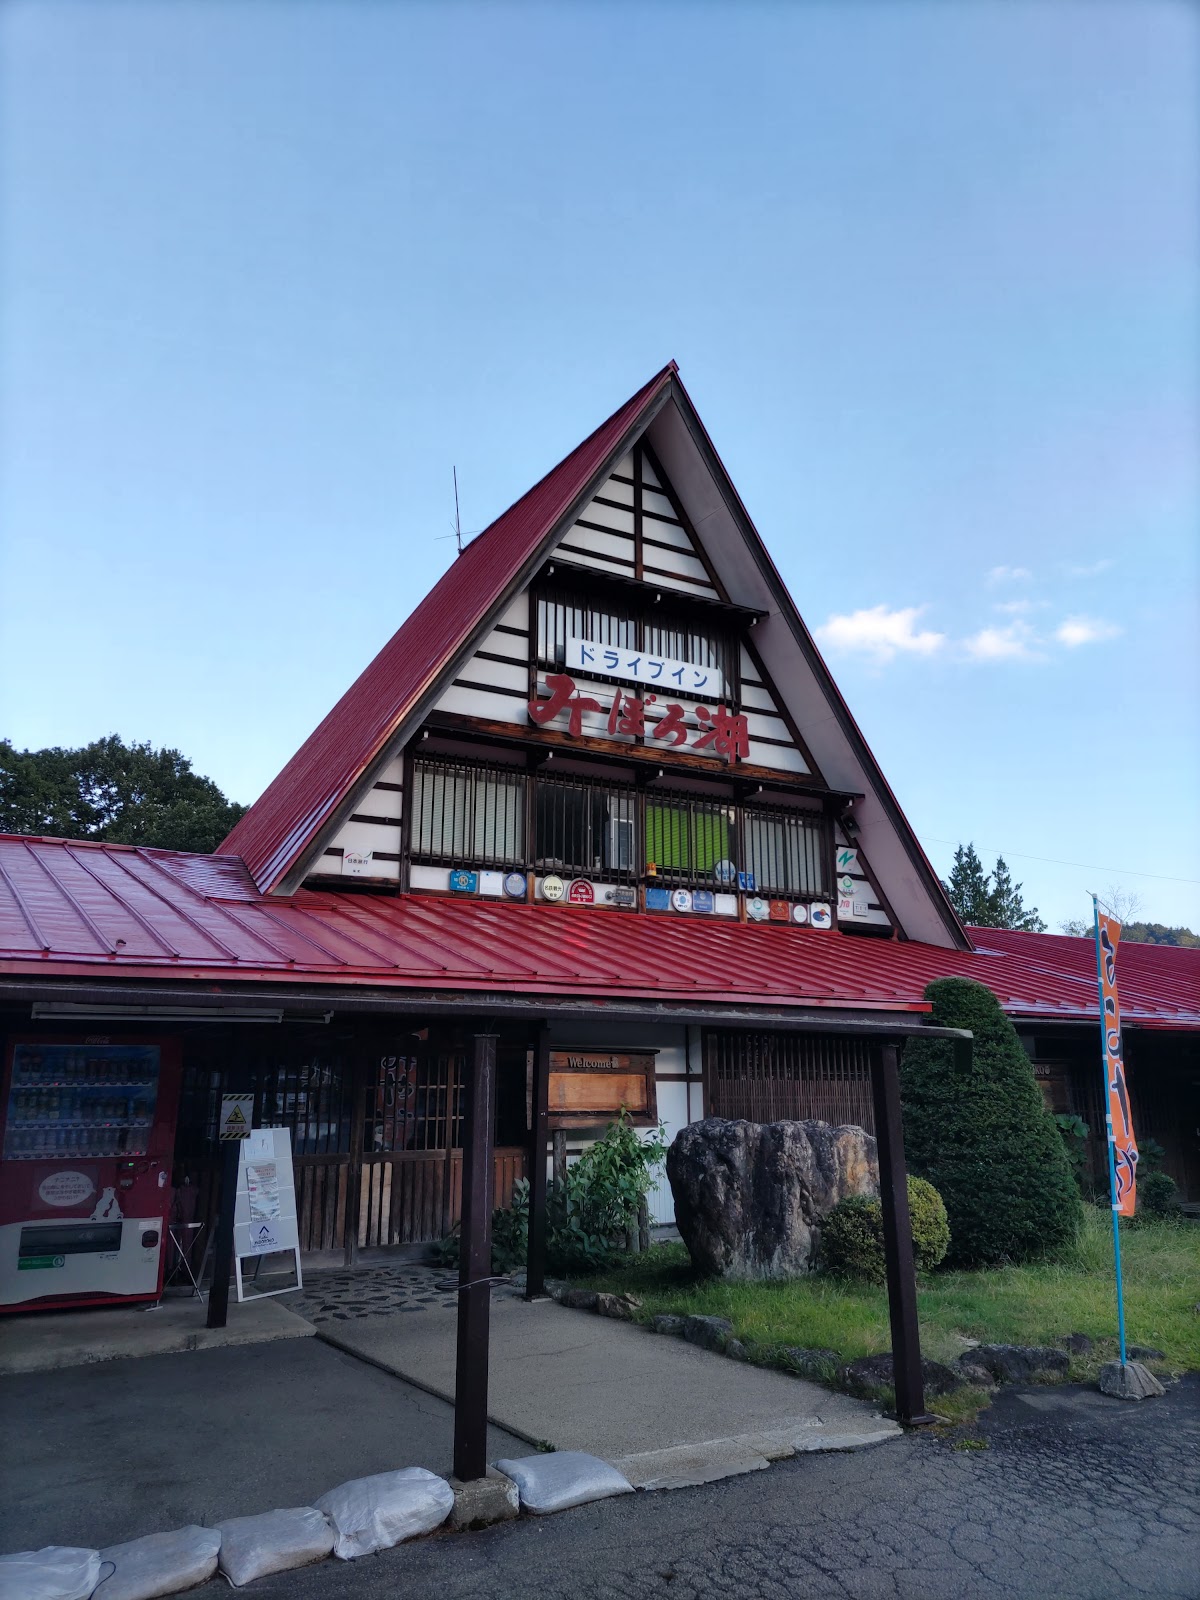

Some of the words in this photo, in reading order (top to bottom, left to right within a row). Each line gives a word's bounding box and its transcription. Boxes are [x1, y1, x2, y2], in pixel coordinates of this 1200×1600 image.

[580, 644, 708, 688] ドライブイン
[567, 1055, 612, 1069] Welcome
